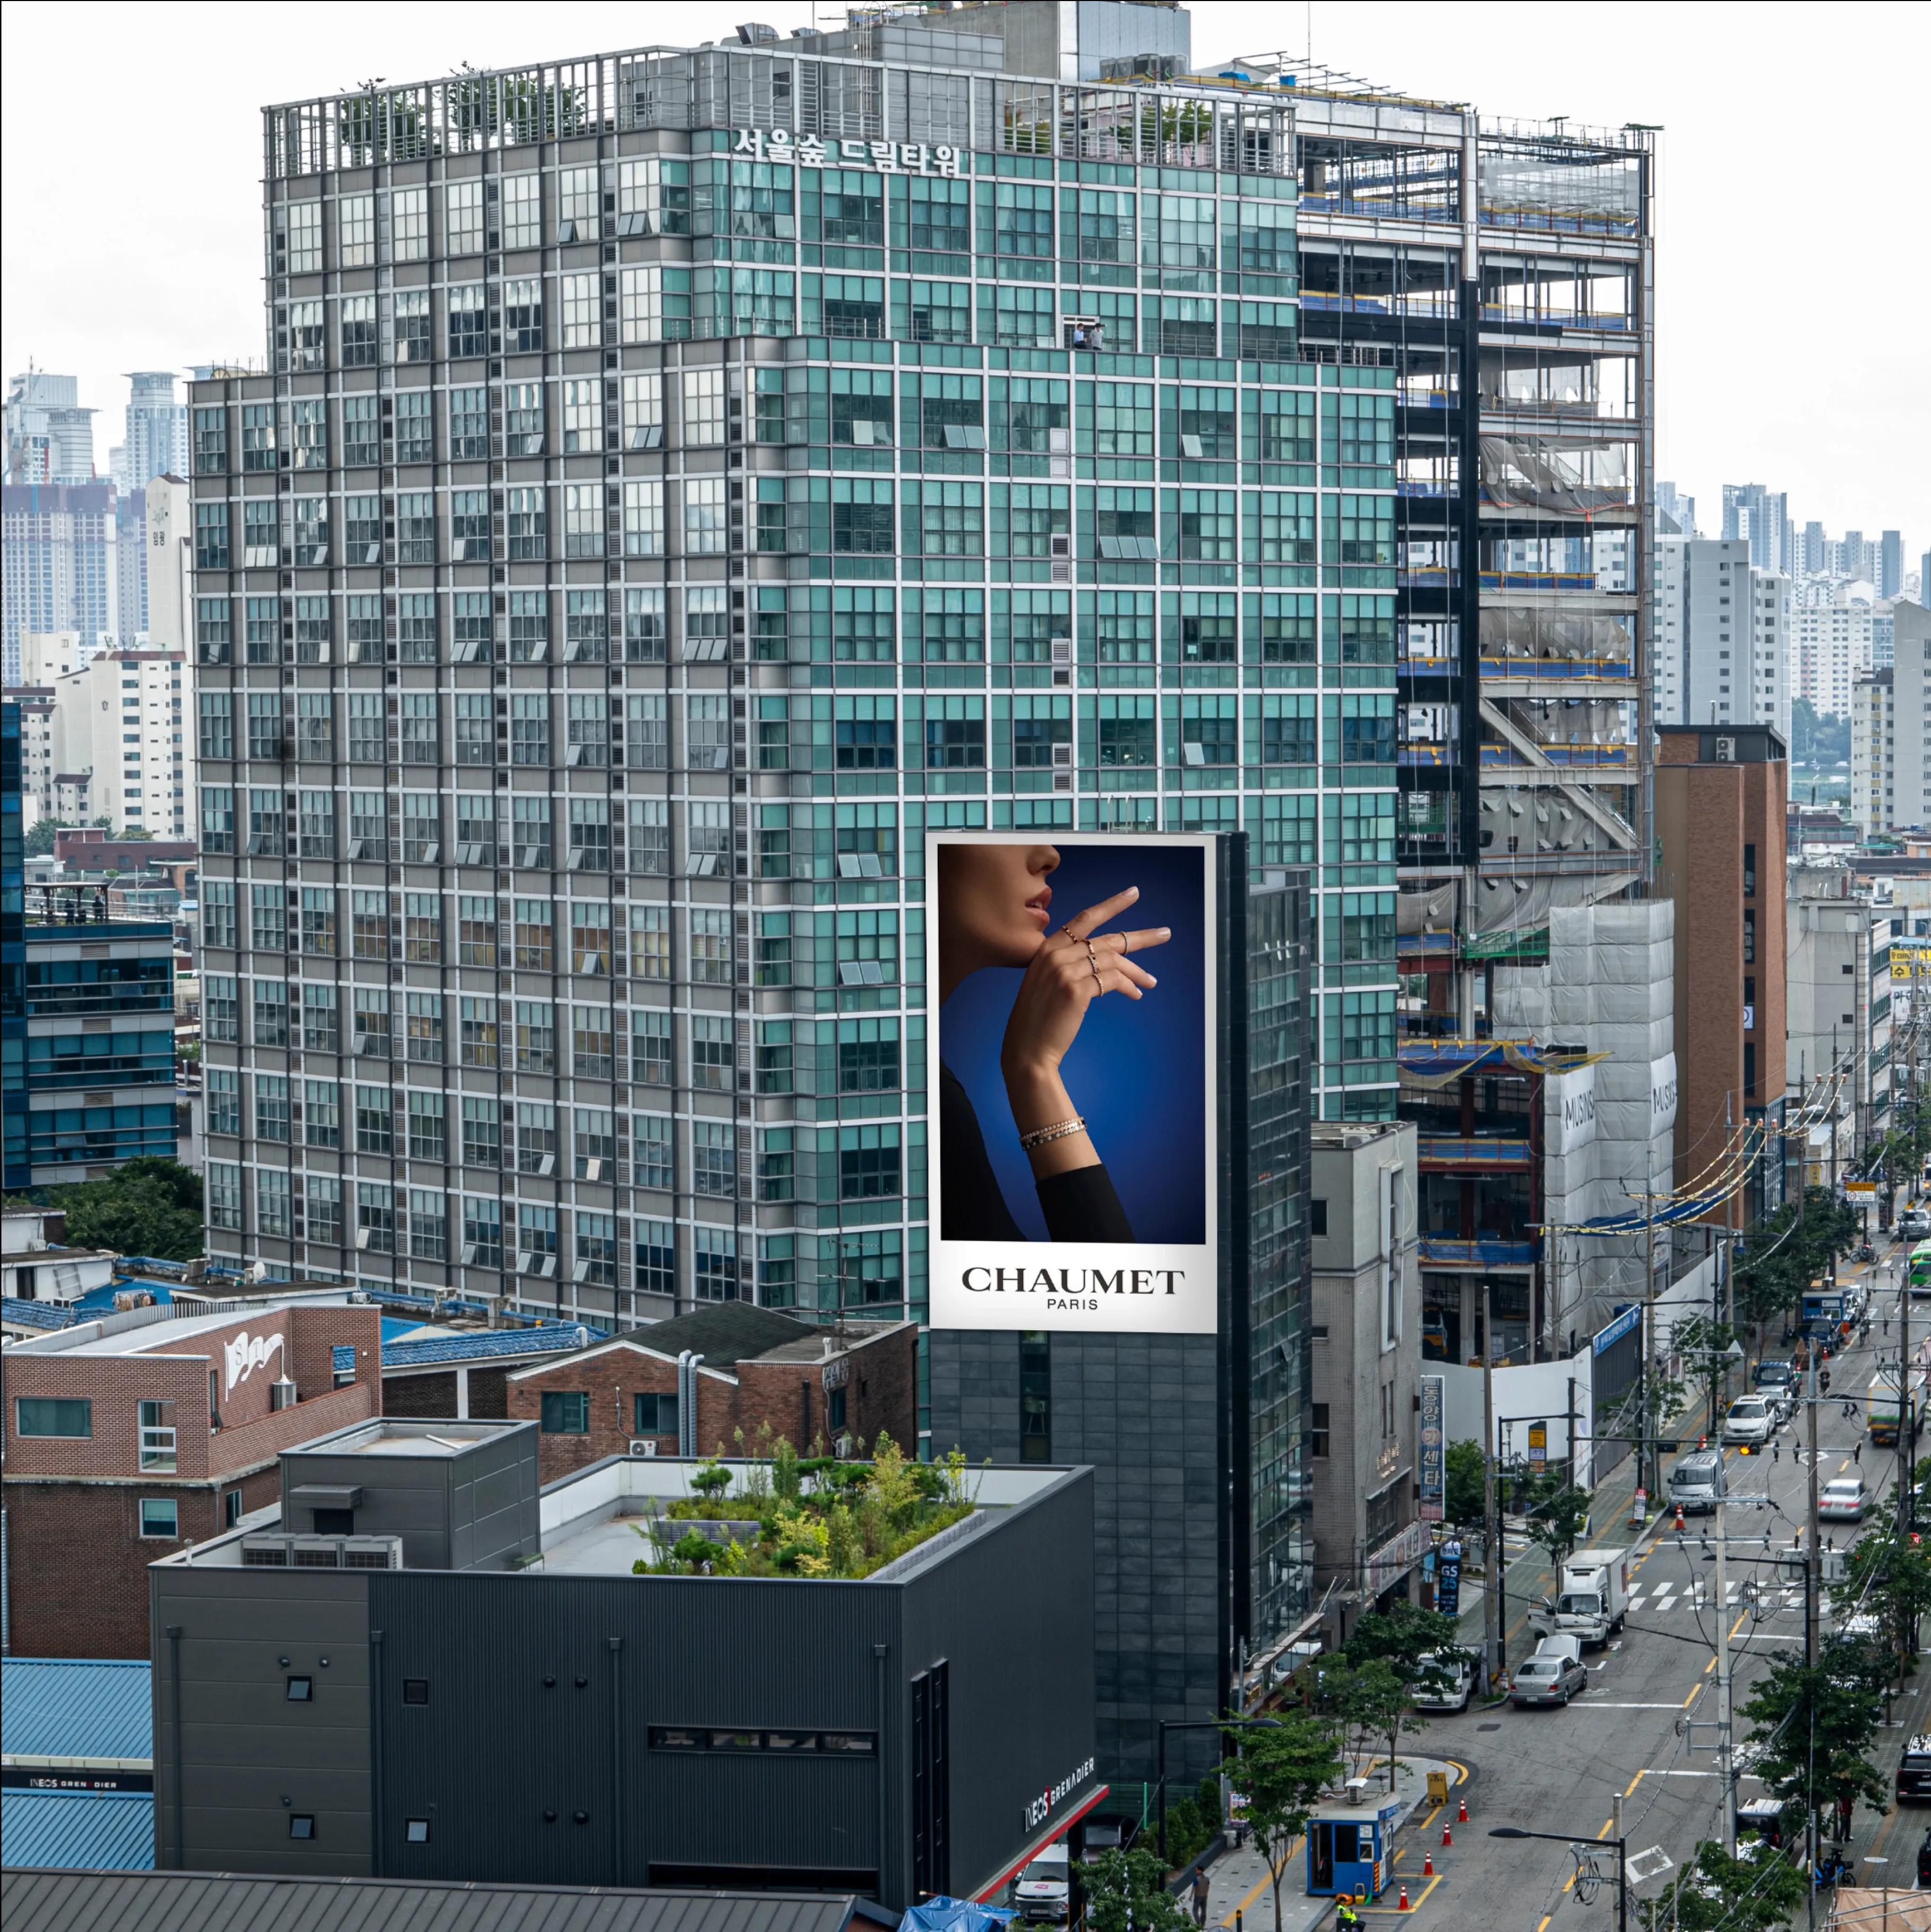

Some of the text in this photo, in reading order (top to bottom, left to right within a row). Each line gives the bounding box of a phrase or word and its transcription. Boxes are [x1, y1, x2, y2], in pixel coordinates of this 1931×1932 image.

[734, 129, 960, 178] 서울숲 드림타워
[962, 1267, 1186, 1295] CHAUMET
[1047, 1298, 1098, 1310] PARIS
[1423, 1385, 1439, 1422] 동양
[1423, 1450, 1440, 1486] 센타
[1441, 1565, 1458, 1577] GS
[1441, 1578, 1457, 1590] 25
[30, 1779, 57, 1788] INEOS
[1025, 1757, 1094, 1832] INEOS GRENADIER
